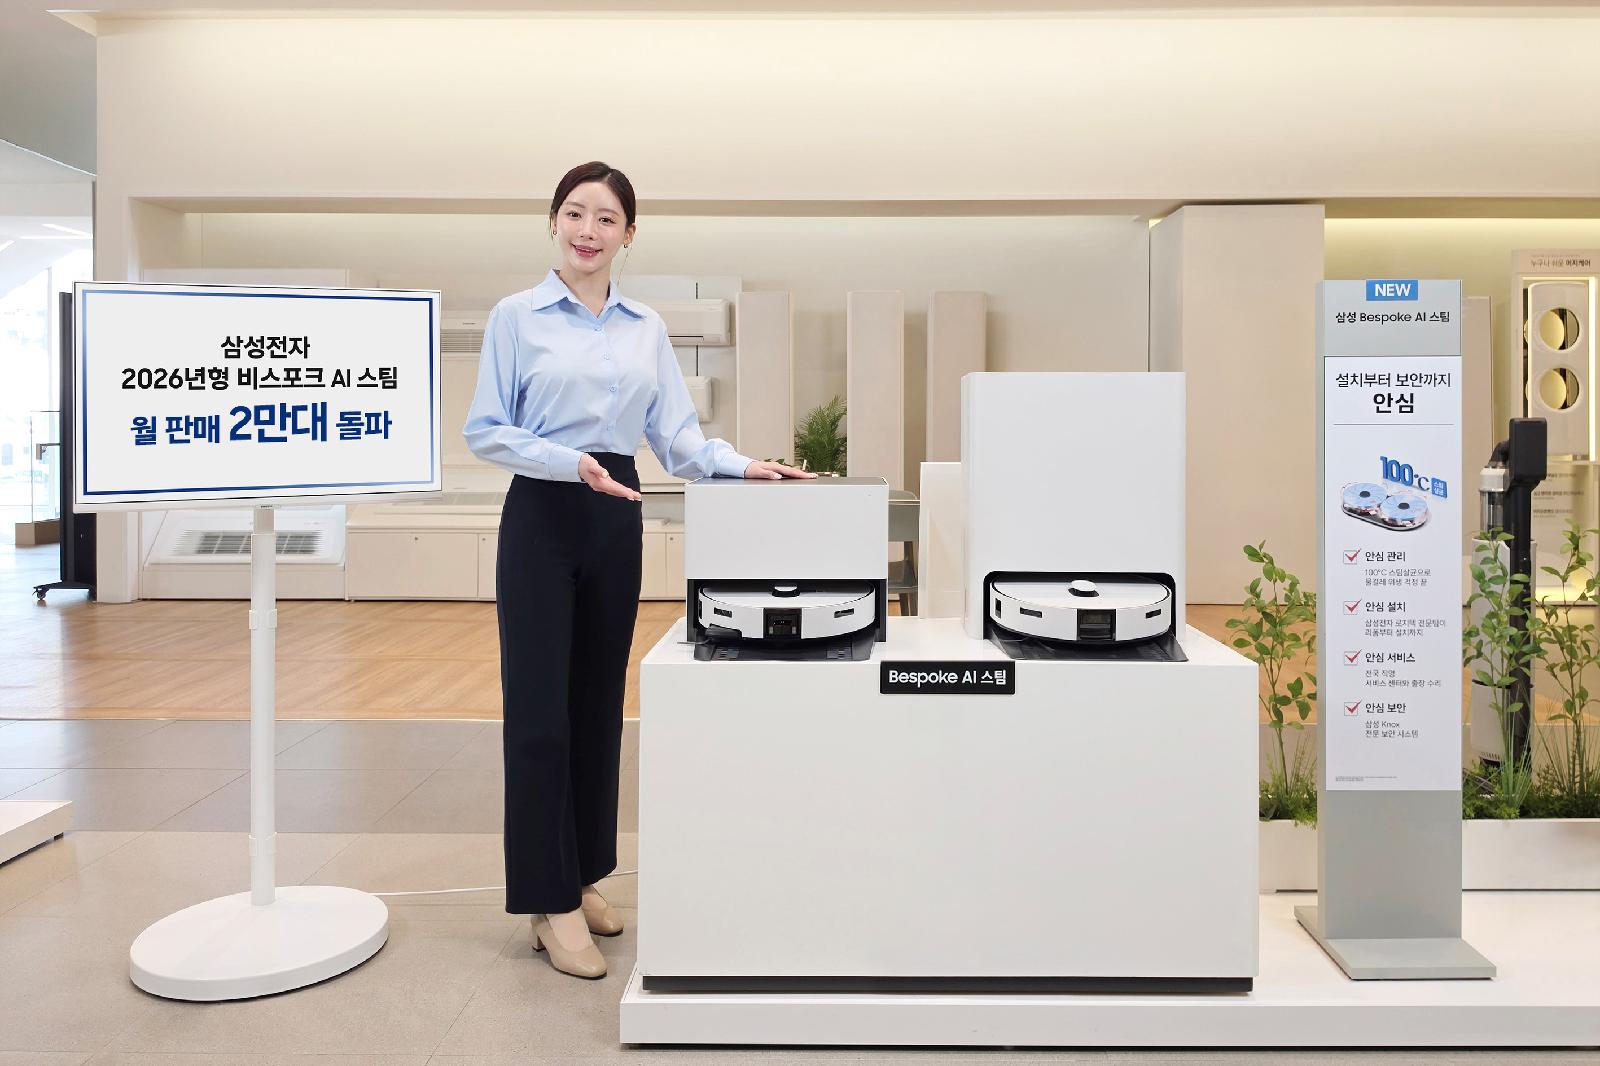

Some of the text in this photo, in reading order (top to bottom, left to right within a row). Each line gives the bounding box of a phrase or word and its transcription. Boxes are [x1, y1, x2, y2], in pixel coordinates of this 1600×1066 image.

[1374, 283, 1411, 297] NEW
[1335, 311, 1450, 325] 삼성 Bespoke AI 스팀
[220, 335, 311, 359] 삼성전자
[121, 367, 398, 391] 2026년형 비스포크 AI 스팀
[1335, 373, 1451, 388] 설치부터 보안까지
[1373, 392, 1414, 414] 안심
[130, 401, 393, 446] 월 판매 2만대 돌파
[1365, 551, 1406, 562] 안심 관리
[1365, 601, 1406, 612] 안심 설치
[1365, 652, 1416, 663] 안심 서비스
[888, 669, 1007, 688] Bespoke AI 스팀
[1365, 702, 1407, 713] 안심 보안
[1381, 720, 1400, 728] Knox
